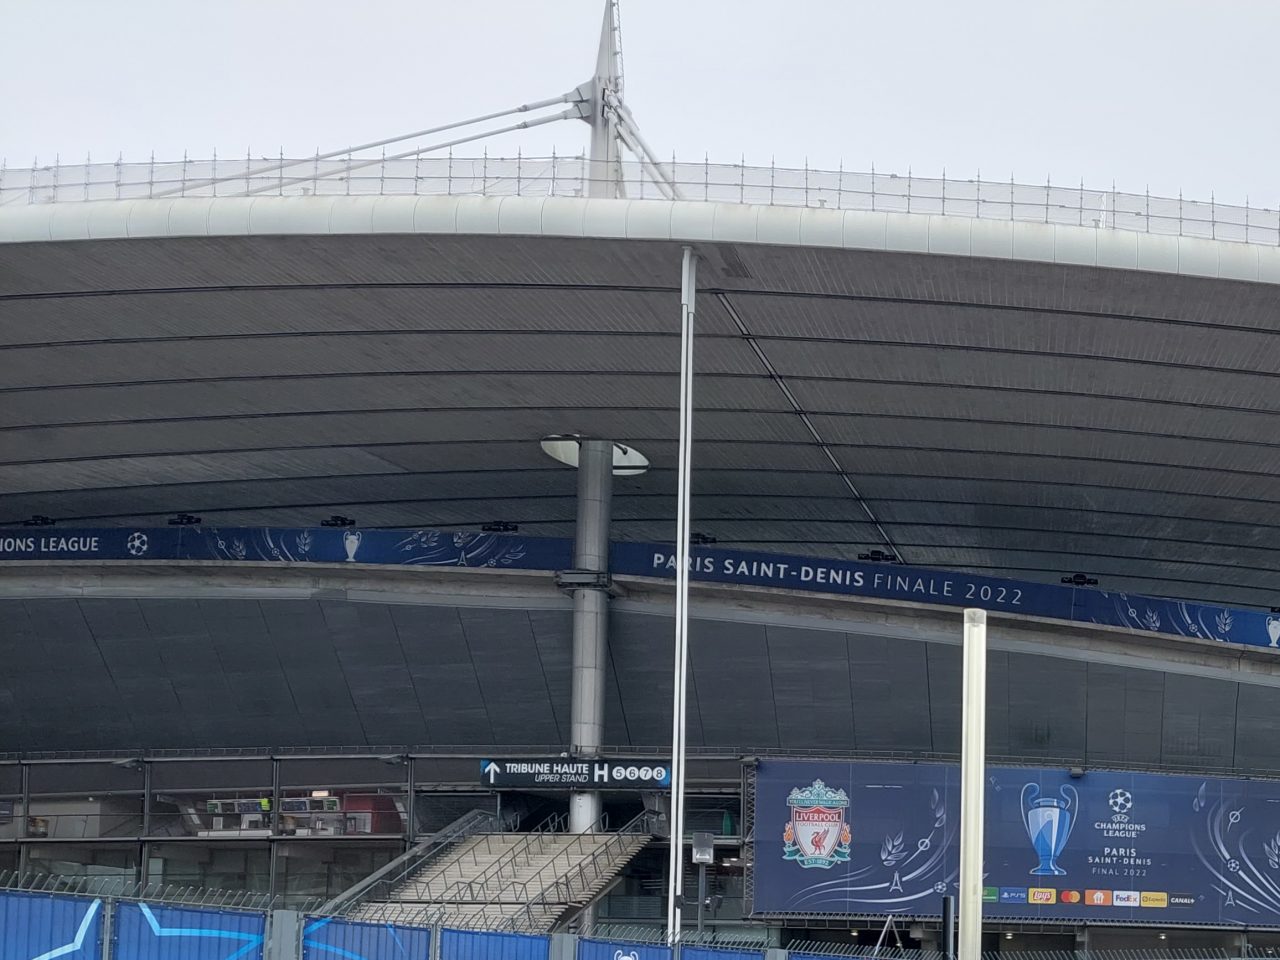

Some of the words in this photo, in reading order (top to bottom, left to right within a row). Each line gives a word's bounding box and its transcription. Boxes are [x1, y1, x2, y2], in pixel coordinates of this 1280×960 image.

[41, 537, 99, 551] LEAGUE
[723, 559, 864, 587] SAINT-DENIS
[873, 573, 953, 596] FINALE
[965, 583, 1022, 605] 2022
[505, 763, 550, 773] TRIBUNE
[553, 763, 589, 773] HAUTE
[593, 763, 608, 782] H
[534, 774, 560, 783] UPPER
[561, 774, 589, 783] STAND
[796, 812, 840, 822] LIVERPOOL
[1094, 822, 1146, 831] CHAMPIONS
[1103, 830, 1137, 838] LEAGUE
[1104, 847, 1137, 857] PARIS
[1088, 856, 1152, 866] SAINT-DENIS
[1092, 867, 1119, 876] FINAL
[1123, 869, 1147, 877] 2022
